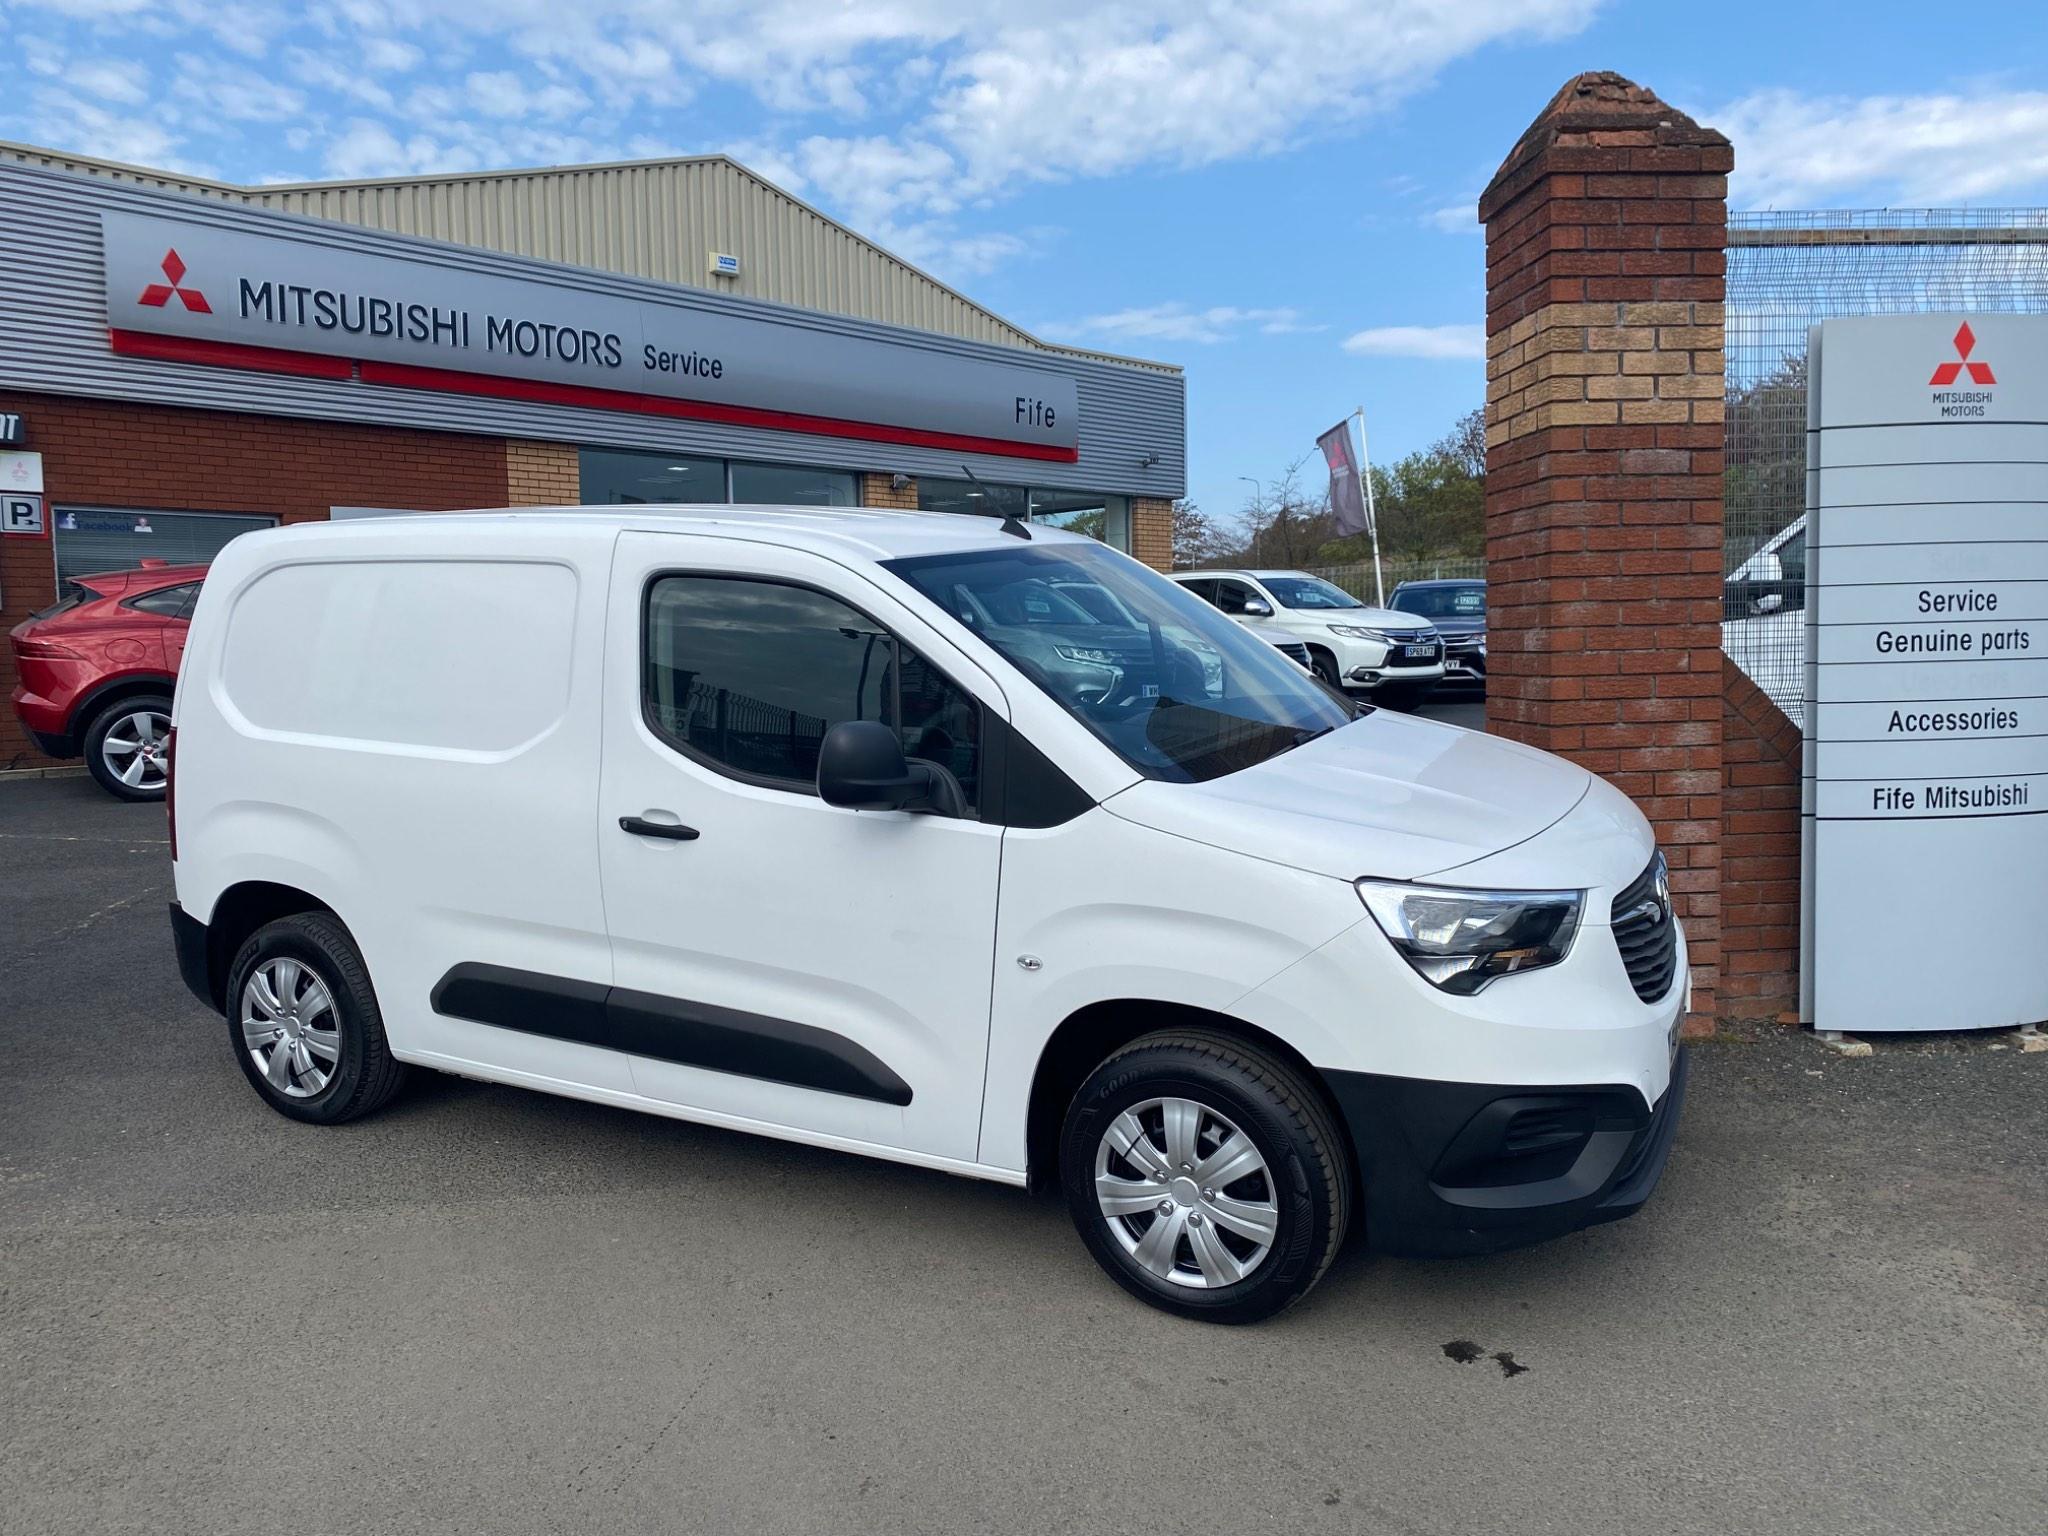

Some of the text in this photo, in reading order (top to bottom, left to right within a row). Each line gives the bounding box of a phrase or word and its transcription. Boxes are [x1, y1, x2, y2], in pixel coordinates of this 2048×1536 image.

[239, 276, 622, 368] MITSUBISHI MOTORS
[643, 344, 723, 380] Service
[1932, 392, 1992, 403] MITSUBISHI
[1015, 396, 1056, 429] Fife
[1941, 405, 1985, 417] MOTORS
[10, 501, 33, 525] P
[1919, 590, 1998, 613] Service
[1876, 629, 2030, 655] Genuine parts
[1887, 707, 2018, 733] Accessories
[1873, 782, 2028, 810] Fife Mitsubishi
